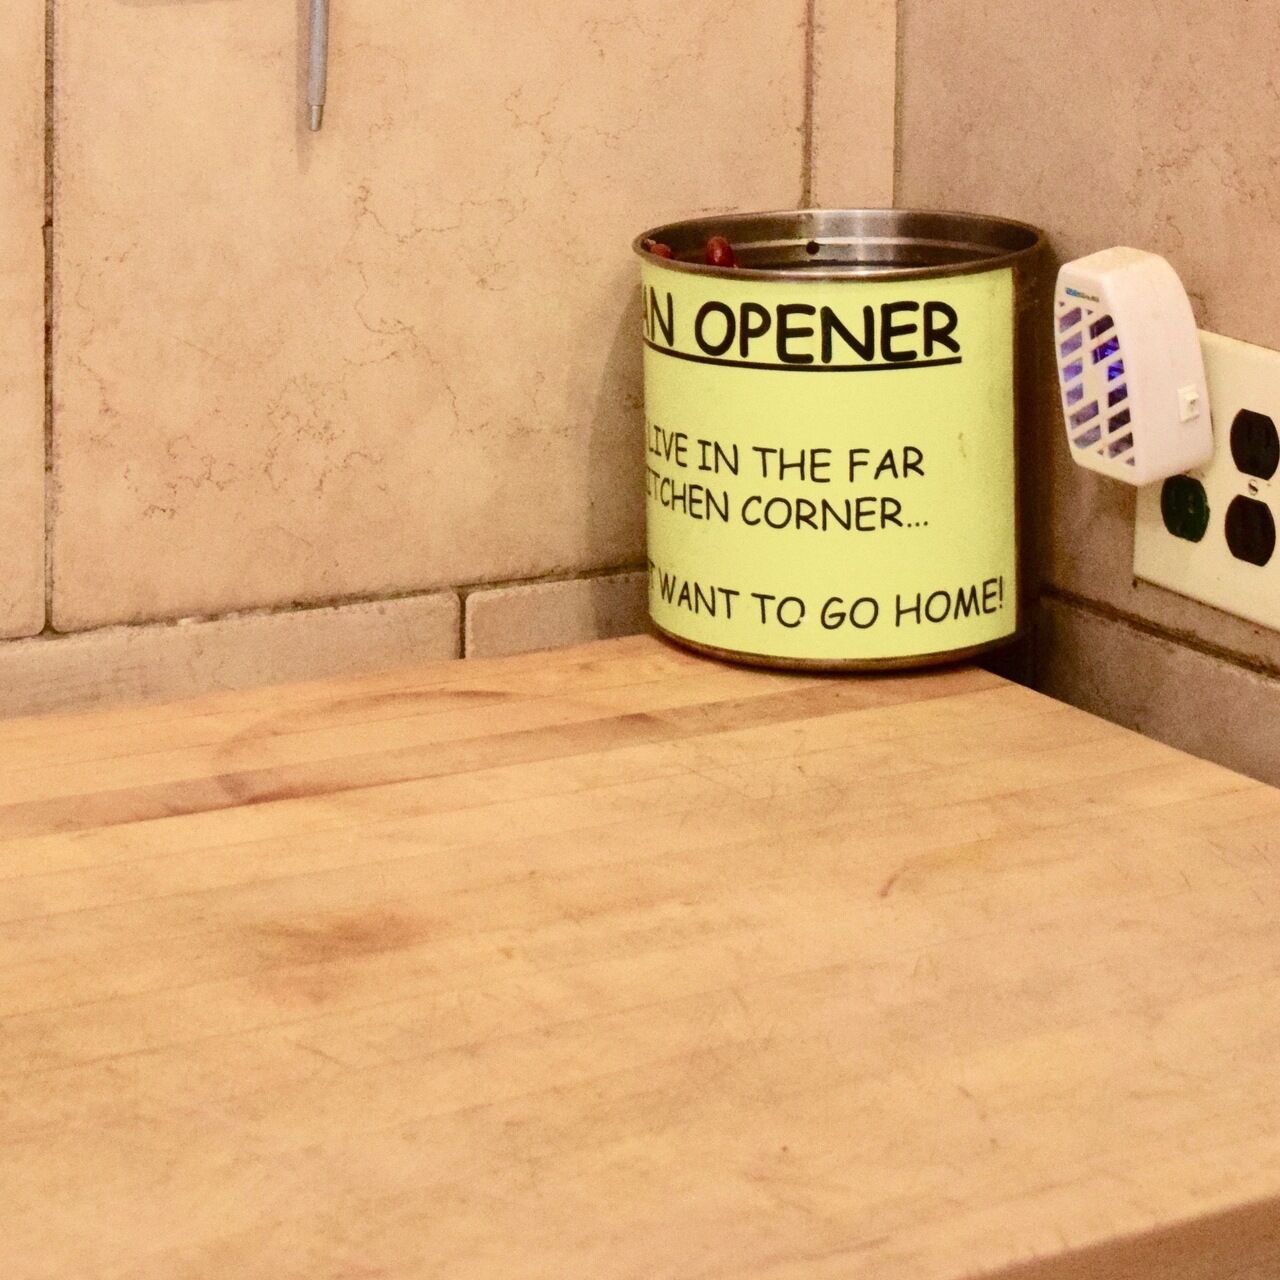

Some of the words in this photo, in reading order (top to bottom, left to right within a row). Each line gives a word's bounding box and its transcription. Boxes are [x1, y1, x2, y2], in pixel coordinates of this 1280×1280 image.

[643, 285, 675, 348] N
[694, 300, 962, 365] OPENER
[697, 439, 739, 476] IN
[751, 446, 833, 484] THE
[848, 445, 925, 483] FAR
[741, 495, 929, 532] CORNER...
[658, 567, 740, 620] WANT
[750, 592, 806, 629] TO
[820, 596, 880, 630] GO
[895, 575, 1004, 628] HOME!
